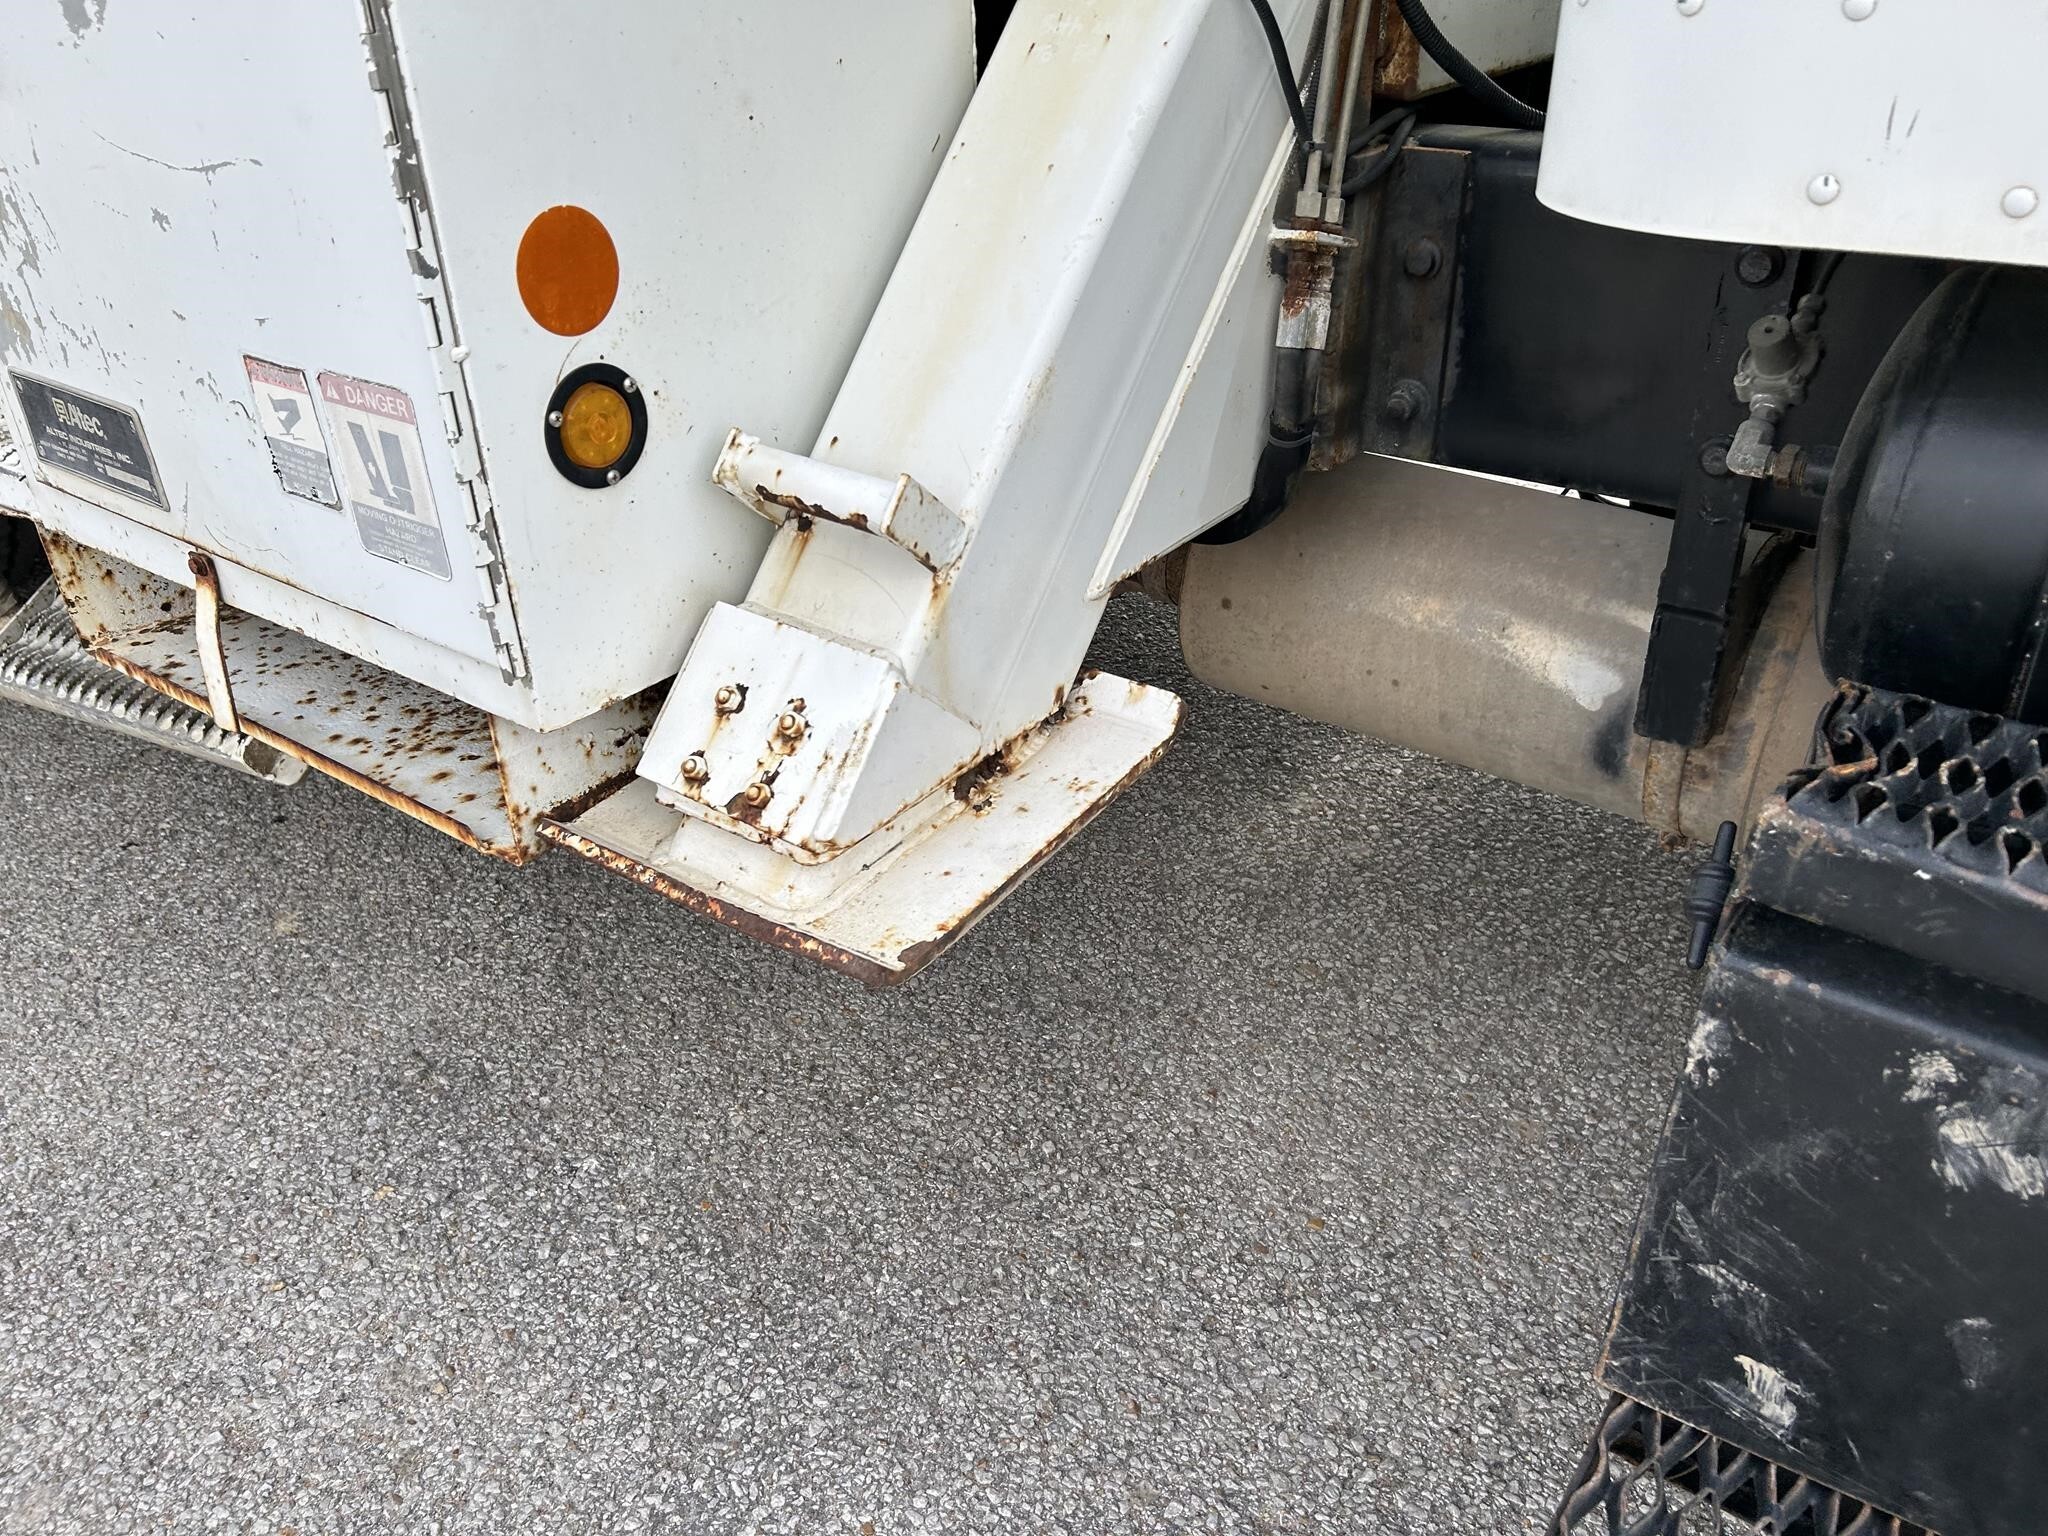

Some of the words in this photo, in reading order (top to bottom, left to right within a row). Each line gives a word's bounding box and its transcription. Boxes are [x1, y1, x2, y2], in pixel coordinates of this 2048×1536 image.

[344, 385, 409, 418] DANGER
[46, 426, 69, 440] ALTEC
[357, 505, 388, 522] MOVING
[385, 526, 417, 544] HAZARD
